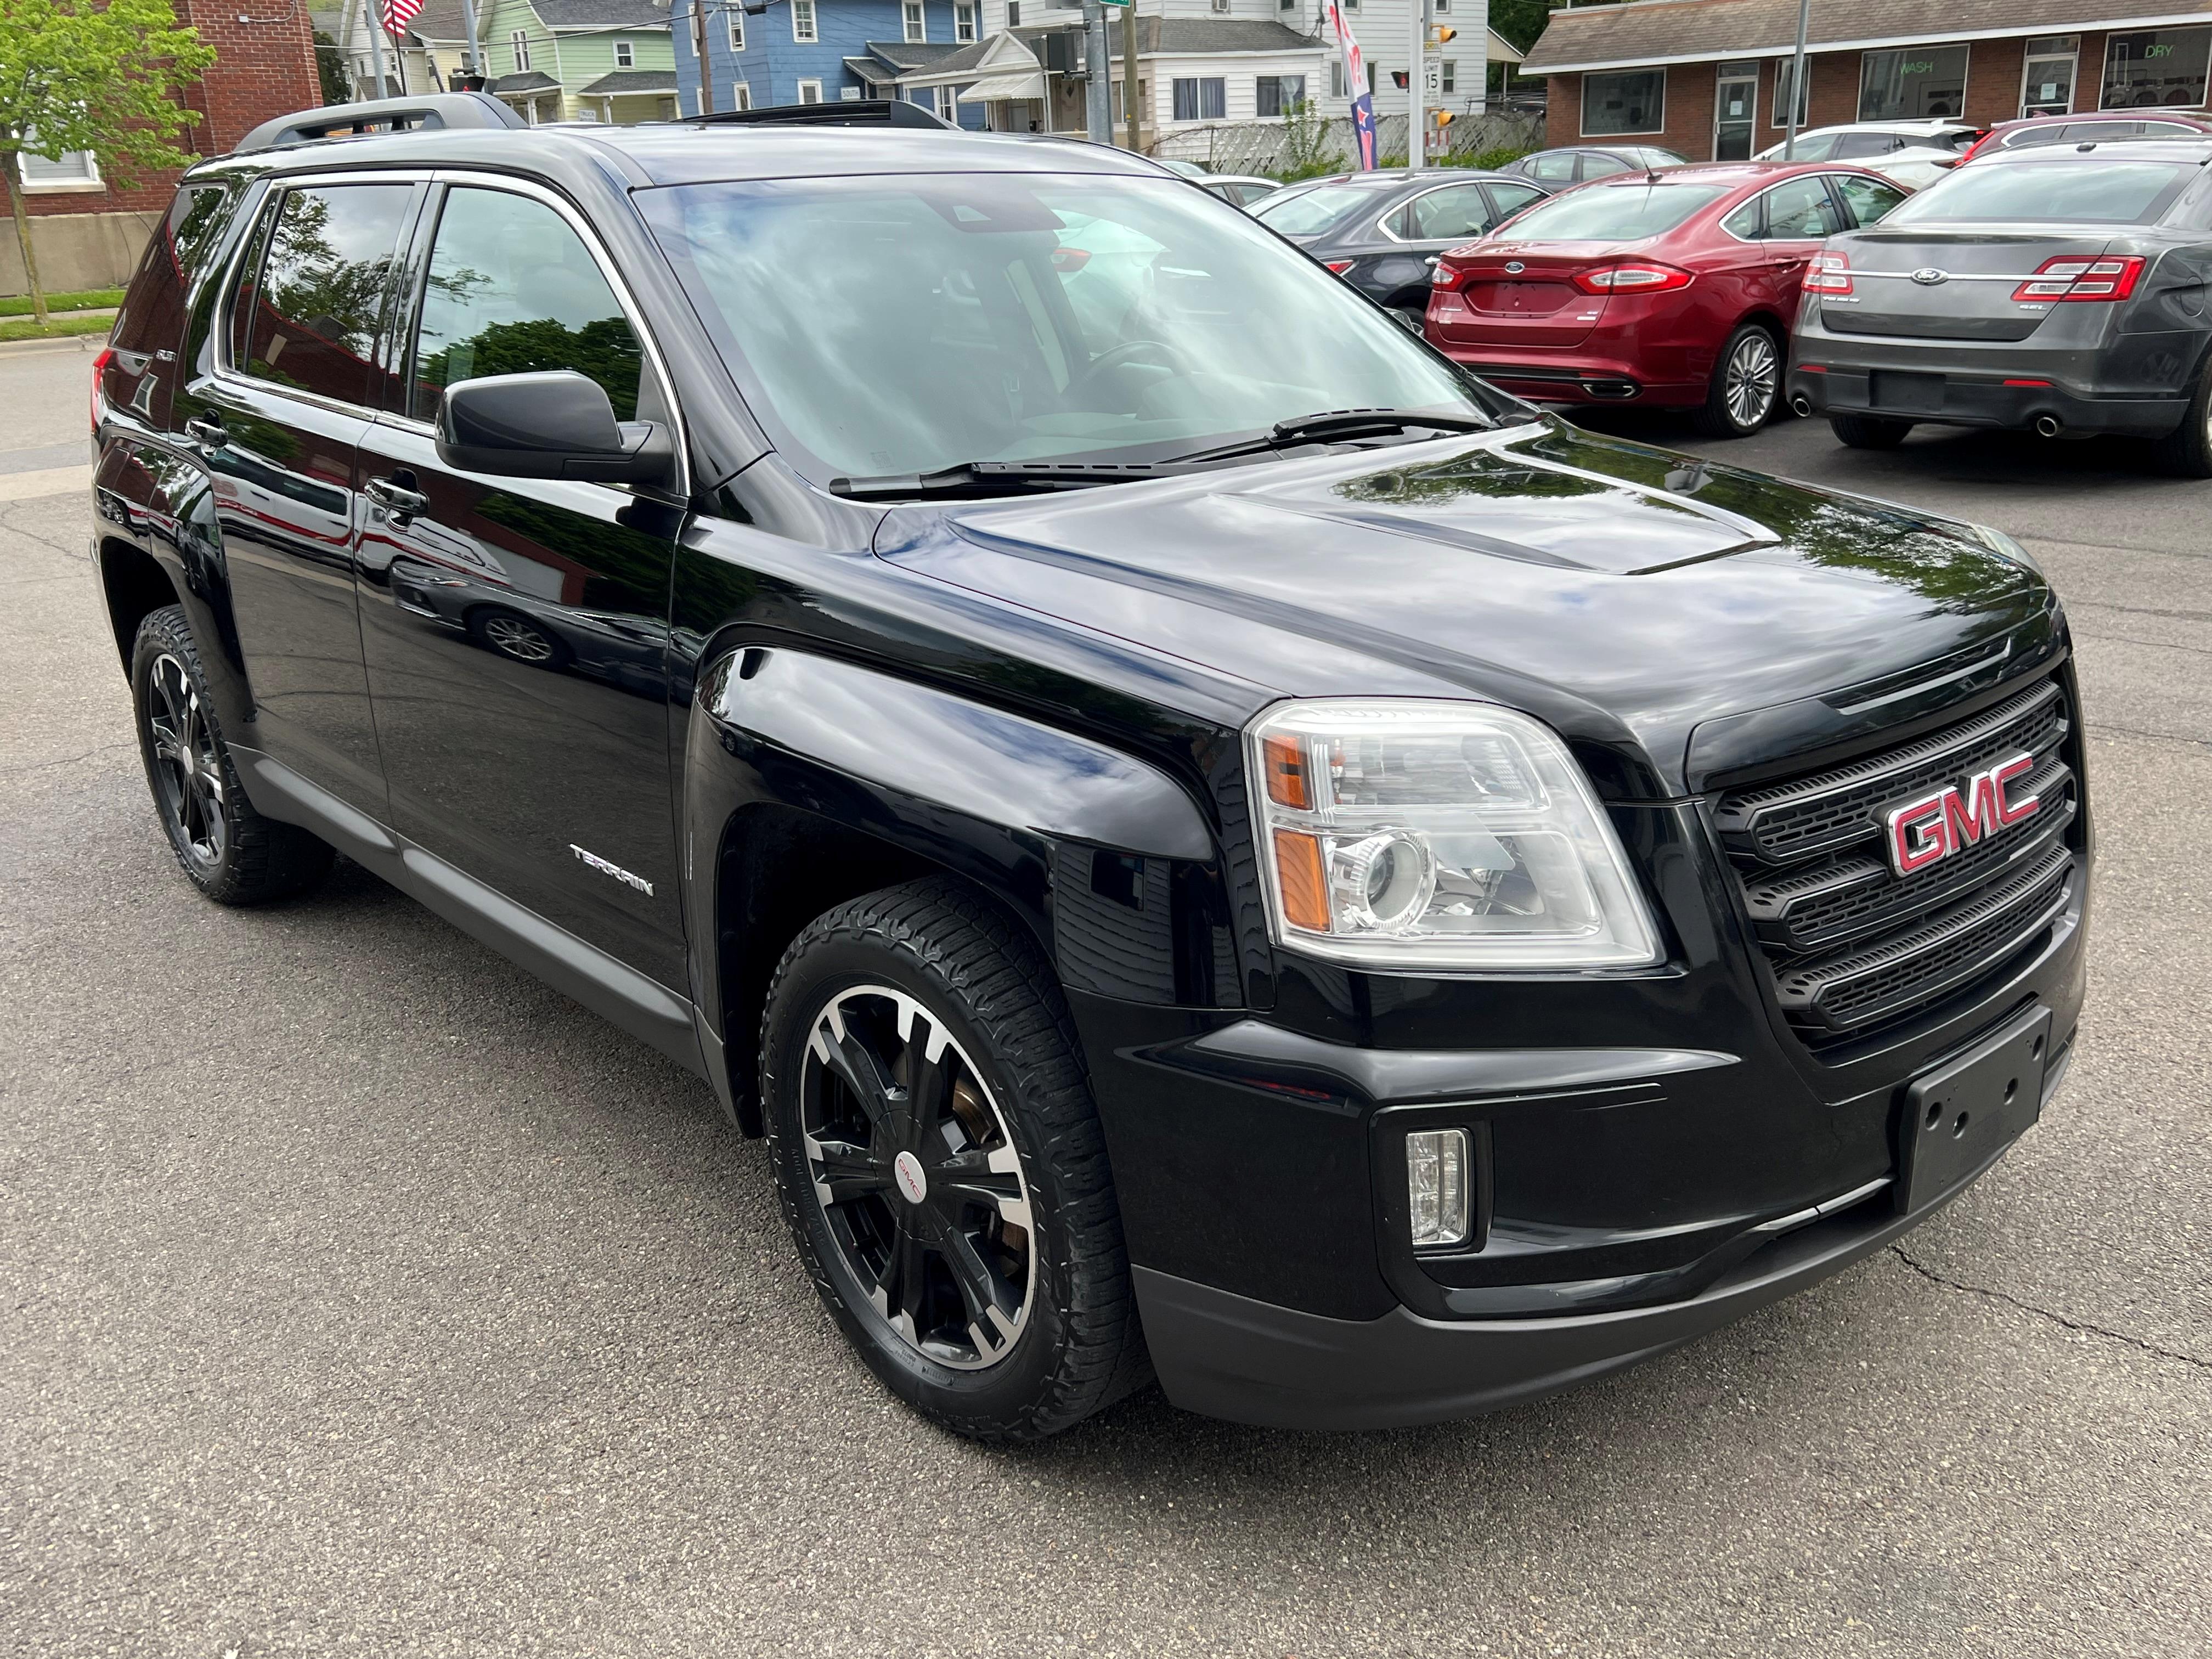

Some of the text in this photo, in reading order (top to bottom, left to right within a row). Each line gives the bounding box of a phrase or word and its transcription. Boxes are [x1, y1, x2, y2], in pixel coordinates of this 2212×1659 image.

[2145, 44, 2175, 59] DRY
[1426, 74, 1438, 89] 15
[1900, 61, 1933, 74] WASH
[1888, 752, 2040, 877] GMC
[569, 843, 654, 897] TERRAIN
[898, 1158, 922, 1199] GMC
